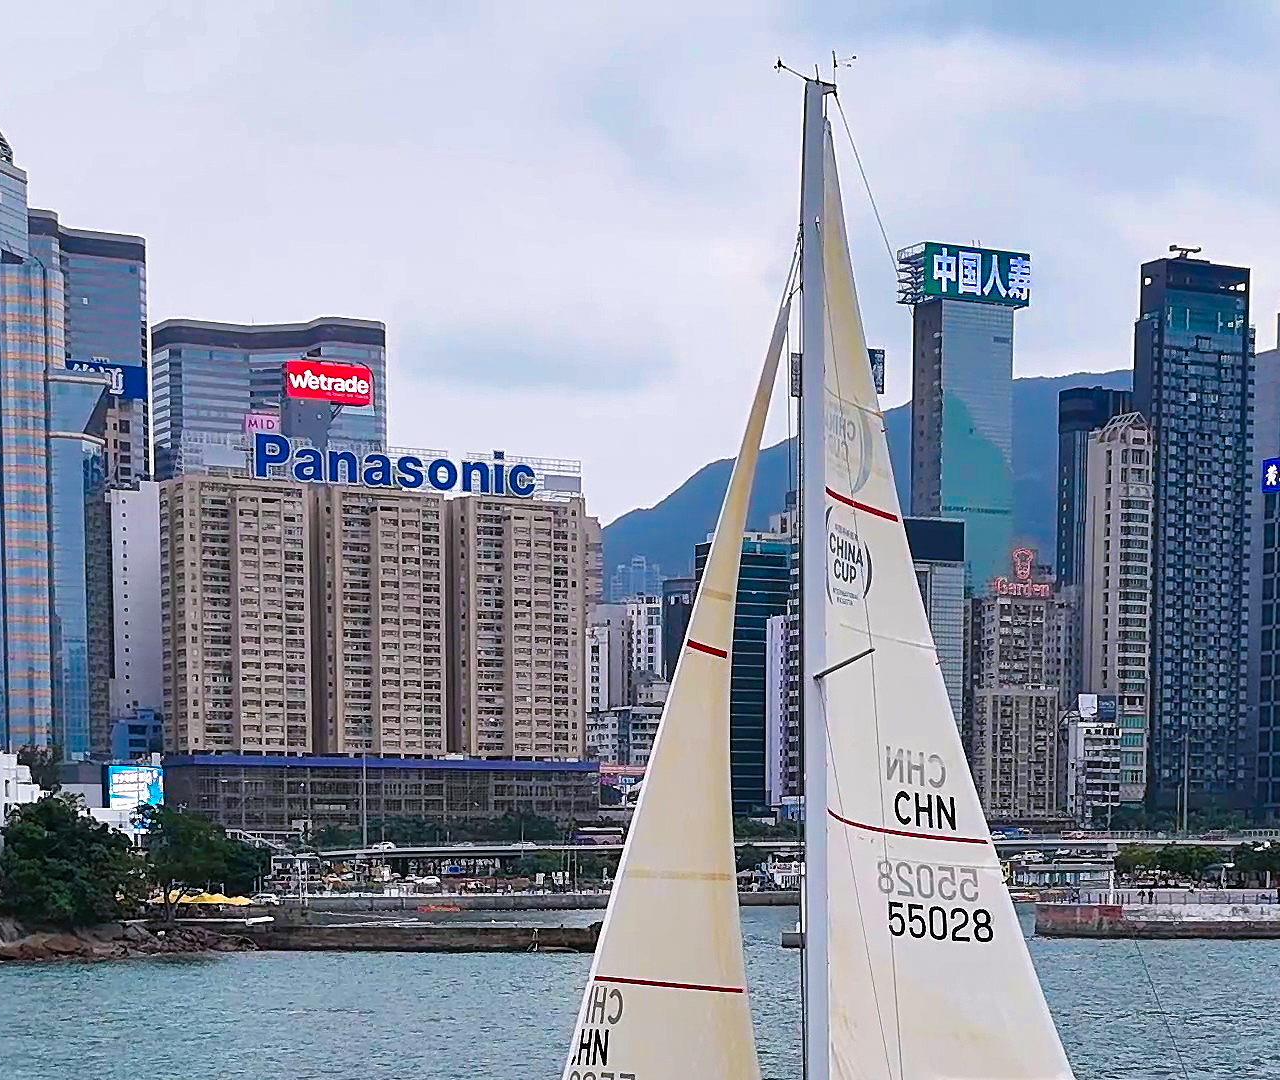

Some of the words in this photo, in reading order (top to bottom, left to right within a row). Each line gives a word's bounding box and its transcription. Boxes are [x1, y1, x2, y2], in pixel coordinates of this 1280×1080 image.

[247, 419, 275, 430] MID
[254, 432, 537, 497] Panasonic
[829, 532, 864, 567] CHINA
[833, 558, 857, 584] CUP
[994, 575, 1050, 598] Garden
[894, 790, 957, 831] CHN
[888, 901, 995, 943] 55028
[571, 1028, 610, 1067] HN
